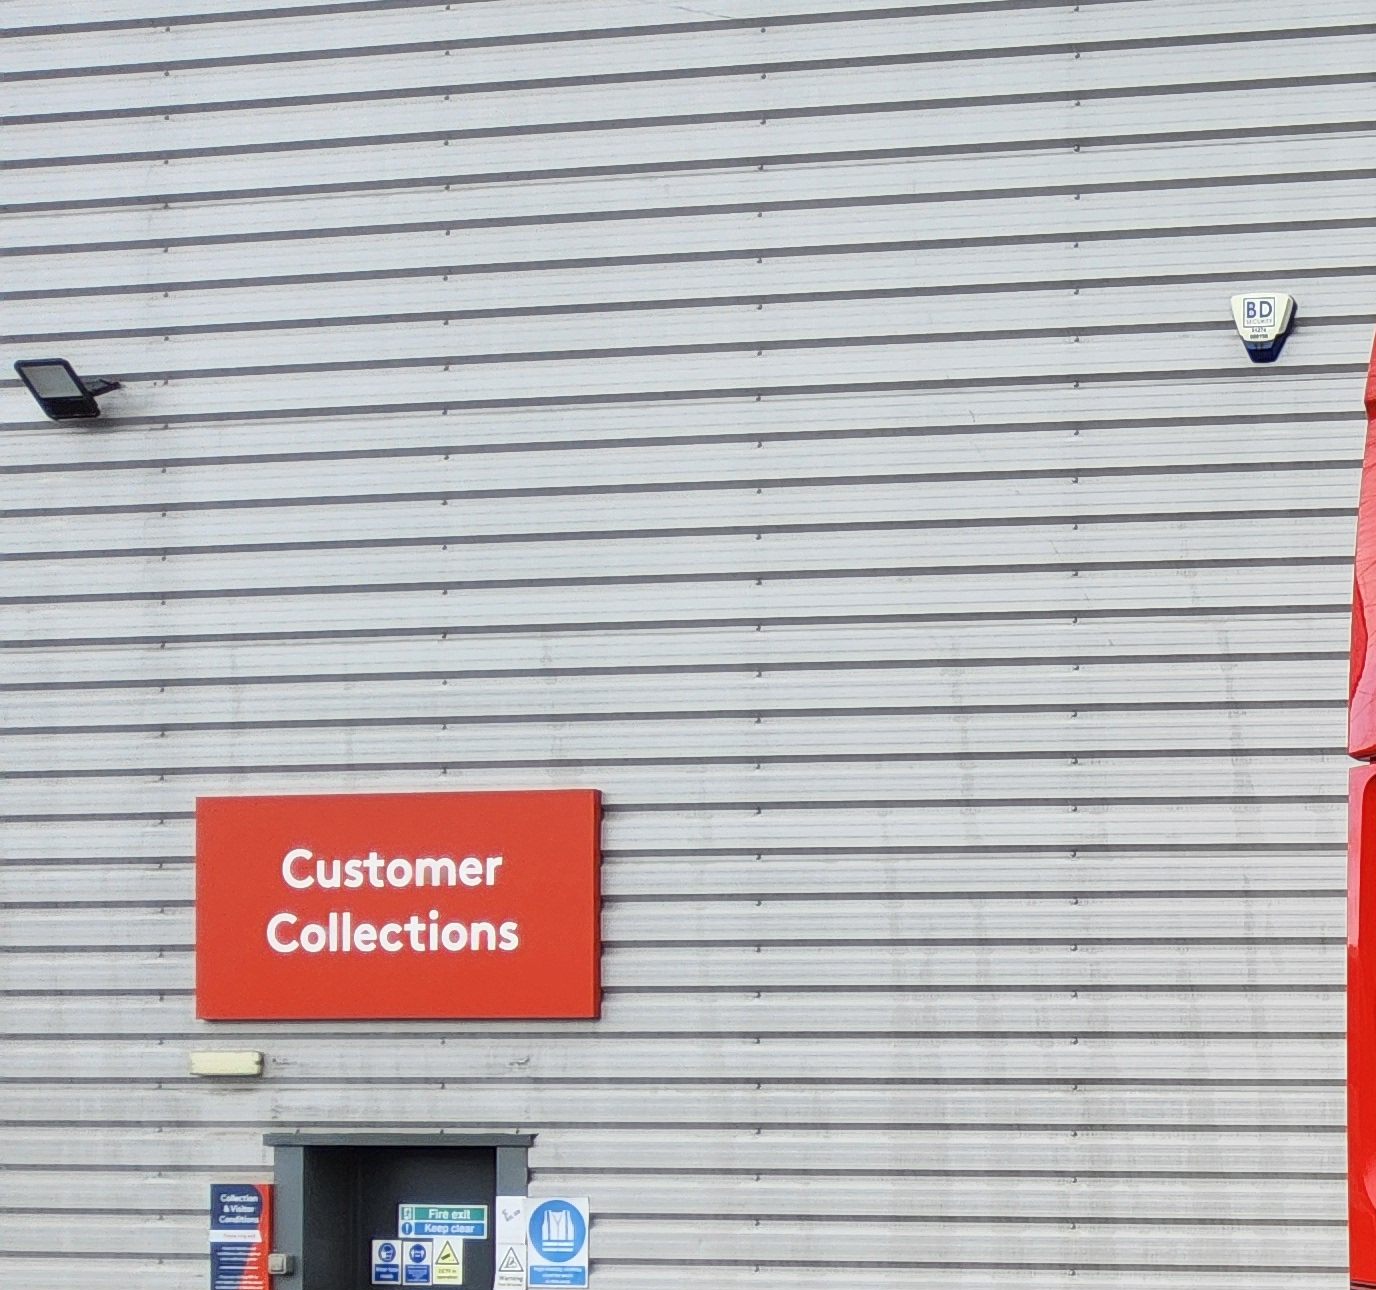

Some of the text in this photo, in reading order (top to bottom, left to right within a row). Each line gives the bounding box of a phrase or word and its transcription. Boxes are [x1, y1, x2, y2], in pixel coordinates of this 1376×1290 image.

[1247, 301, 1272, 318] BD
[281, 848, 504, 889] Customer
[266, 909, 520, 953] Collections
[428, 1208, 471, 1220] Fire exit
[424, 1223, 476, 1235] Keep clear
